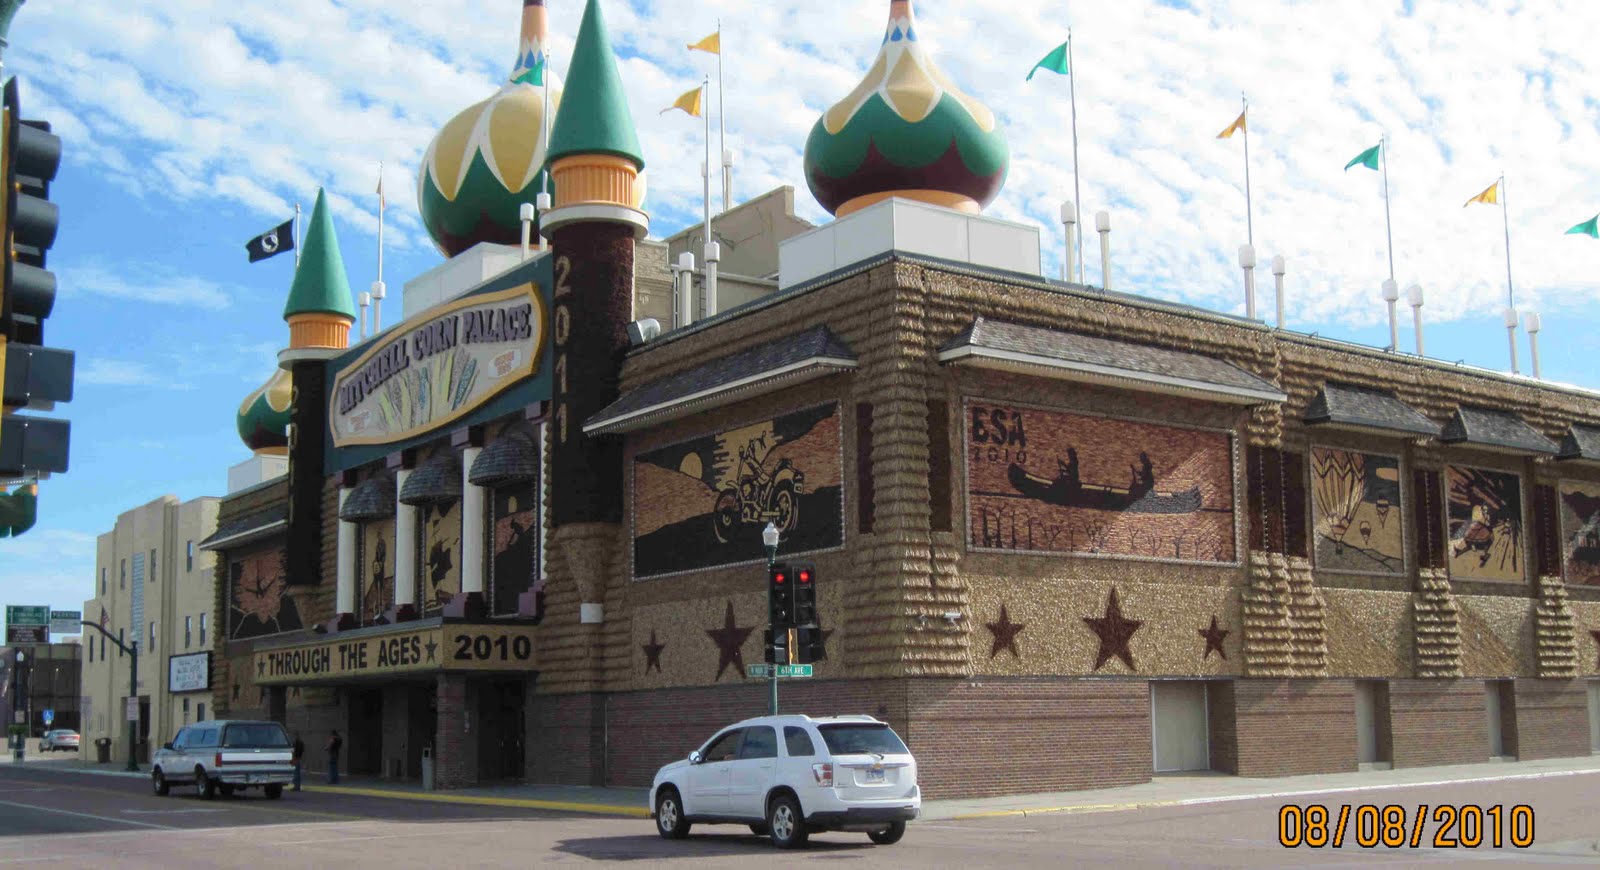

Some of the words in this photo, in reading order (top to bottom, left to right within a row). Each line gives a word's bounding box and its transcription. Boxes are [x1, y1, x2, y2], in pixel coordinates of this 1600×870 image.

[339, 338, 410, 416] MITCHELL
[412, 315, 459, 361] CORN
[461, 302, 532, 344] PALACE
[555, 255, 571, 443] 2011
[972, 407, 1026, 448] ESA
[974, 447, 1027, 464] 2010
[268, 646, 331, 677] THROUGH
[338, 642, 368, 671] THE
[377, 635, 421, 668] AGES
[453, 634, 532, 661] 2010
